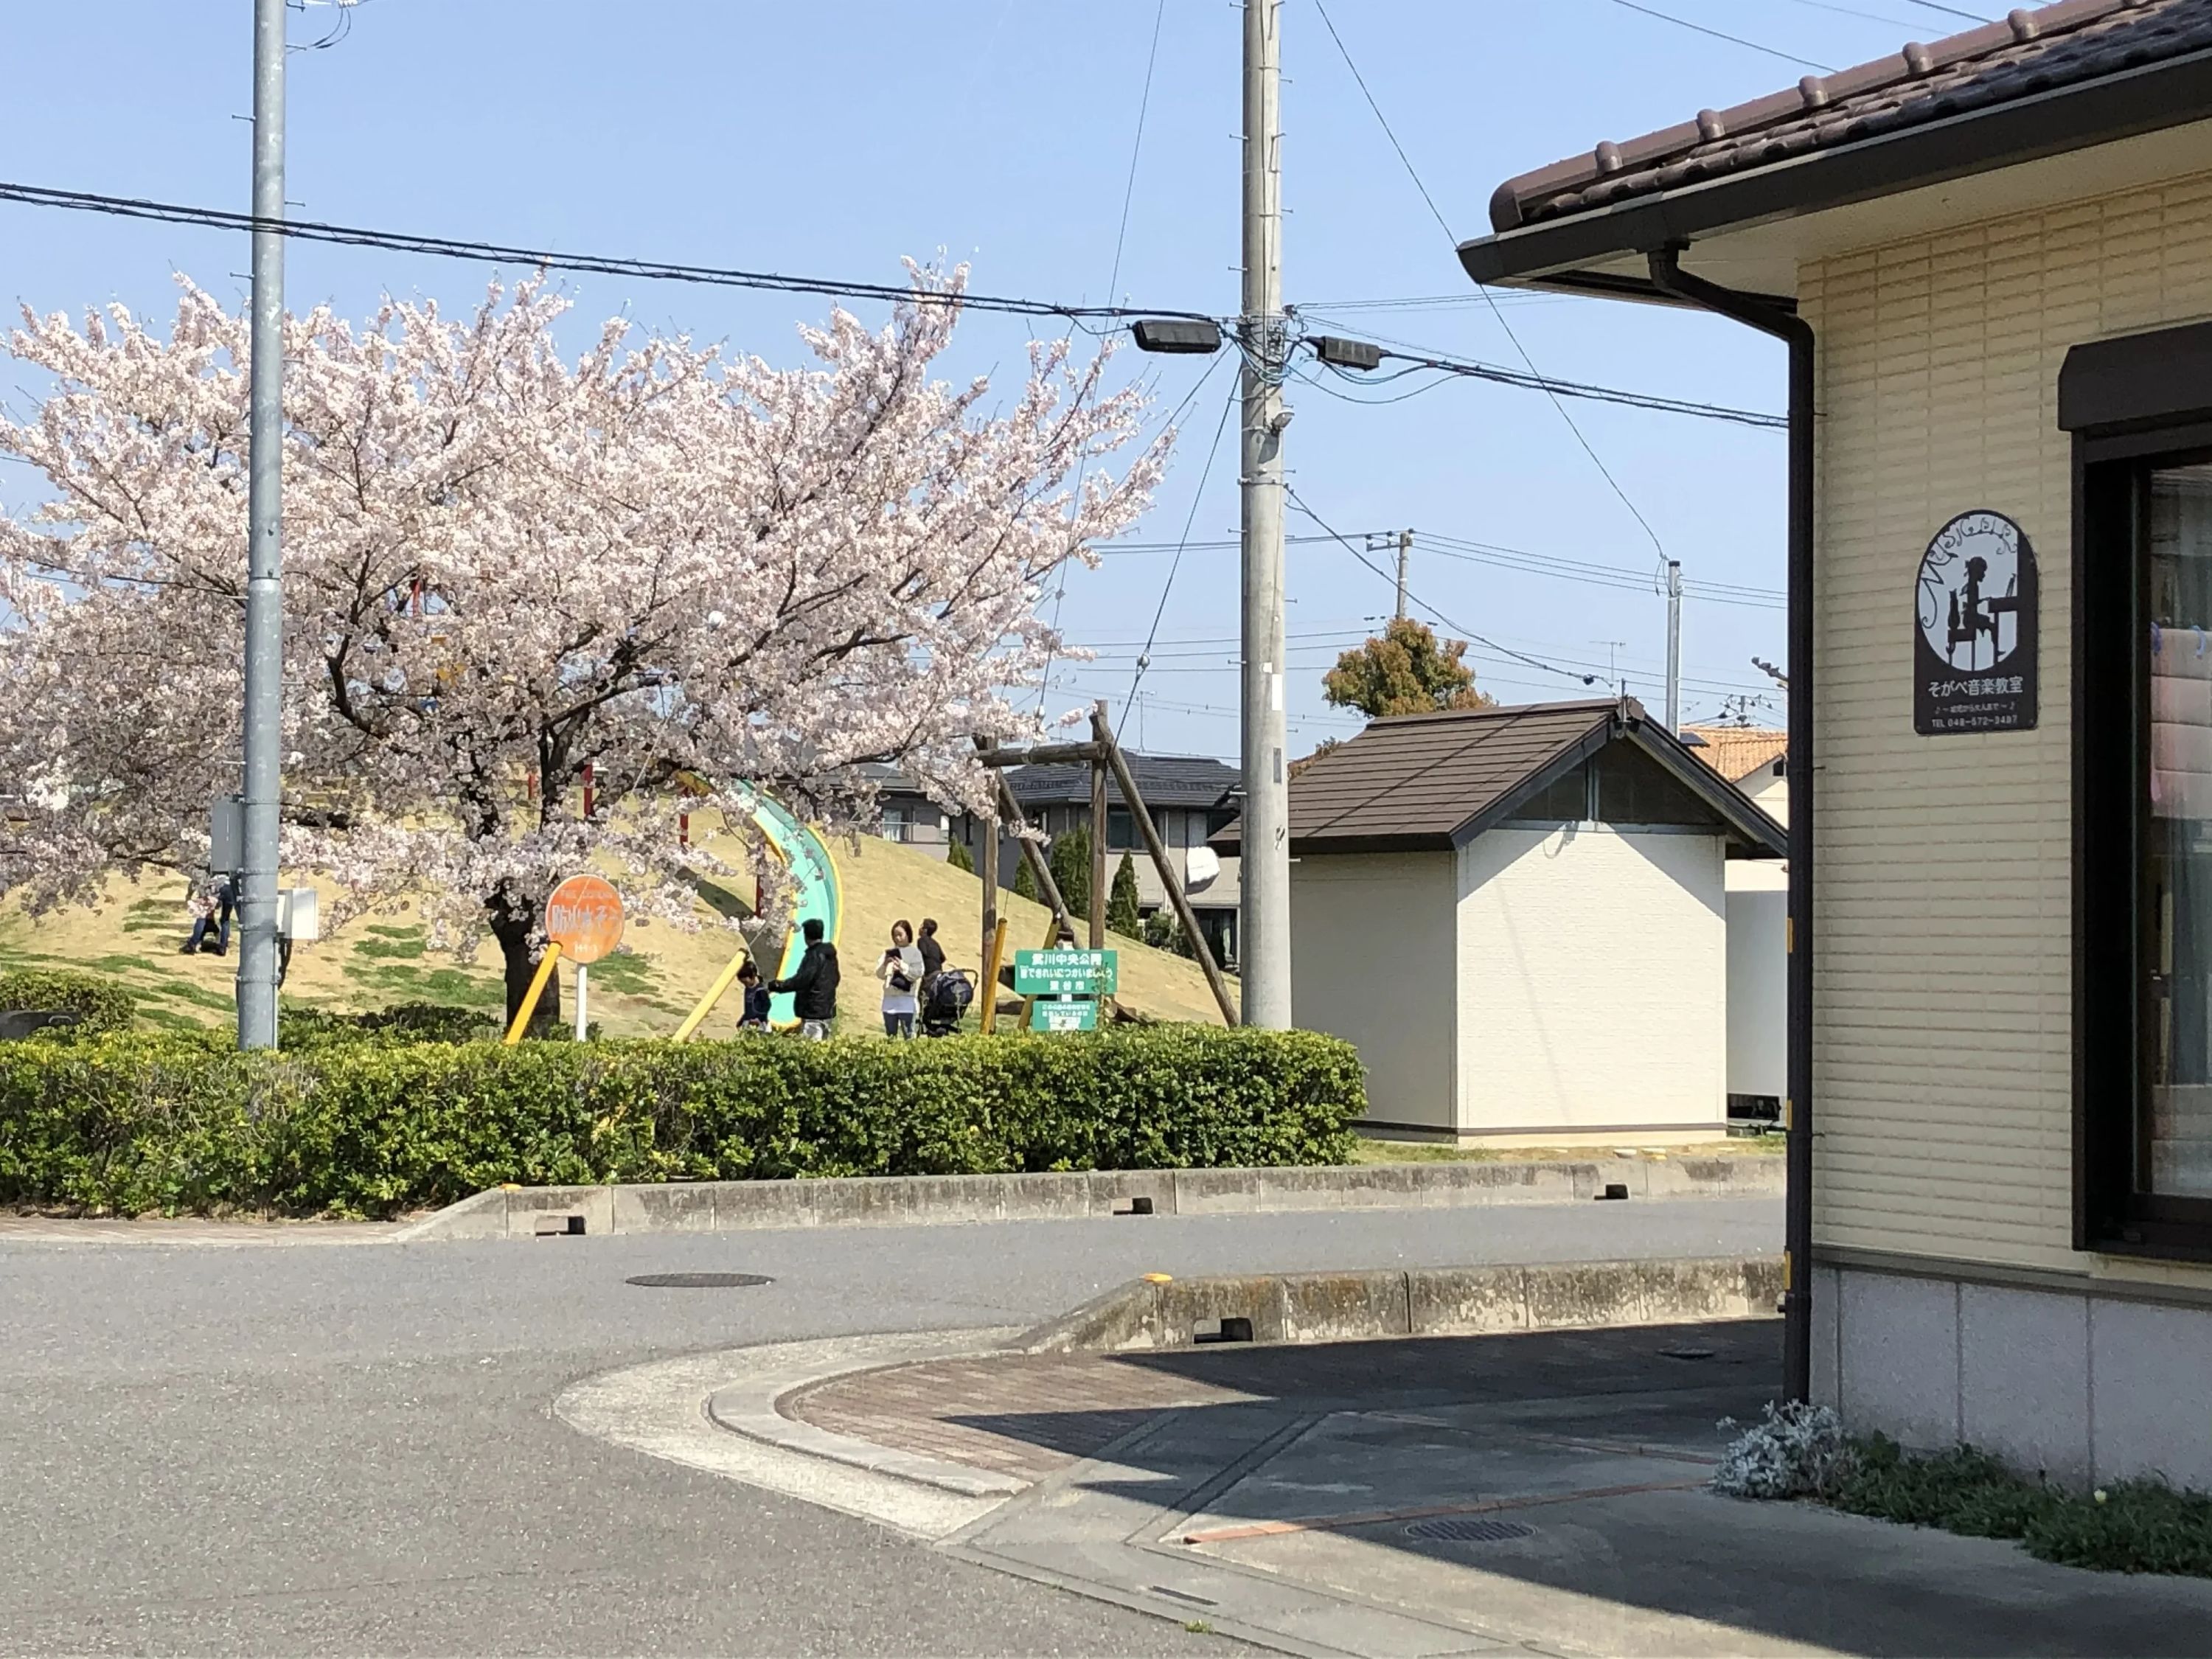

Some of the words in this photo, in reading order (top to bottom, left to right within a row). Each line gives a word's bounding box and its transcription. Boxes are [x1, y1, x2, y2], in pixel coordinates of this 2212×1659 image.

[1928, 676, 2023, 698] そがべ音楽教室
[1932, 718, 1945, 728] TEL
